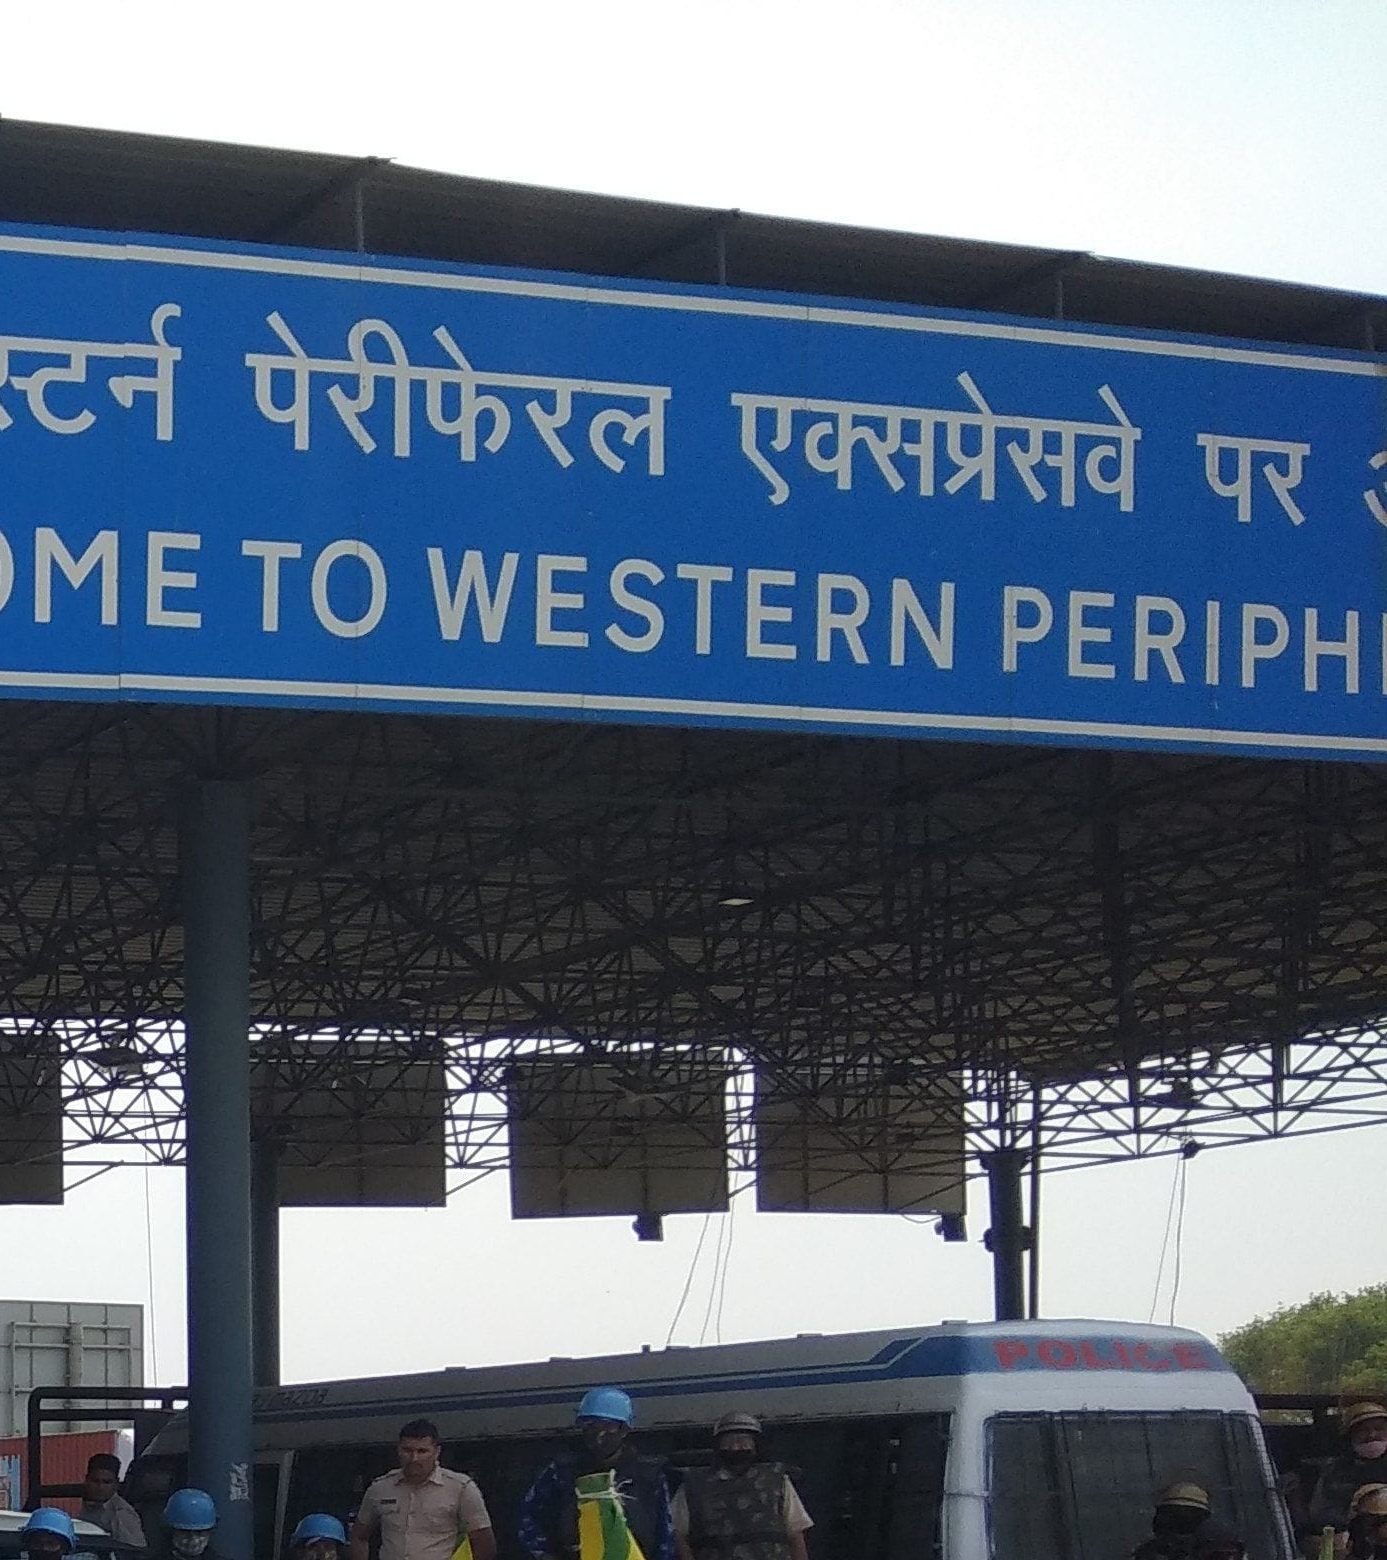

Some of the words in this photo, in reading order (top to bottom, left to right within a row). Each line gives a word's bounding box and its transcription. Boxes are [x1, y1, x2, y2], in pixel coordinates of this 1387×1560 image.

[244, 313, 672, 476] पेरीफेरल
[730, 372, 1141, 516] एक्सप्रेसवे
[1196, 433, 1311, 526] पर
[241, 539, 387, 638] TO
[427, 547, 955, 669] WESTERN
[1003, 585, 1387, 695] PERIPH
[993, 1339, 1212, 1371] POLICE
